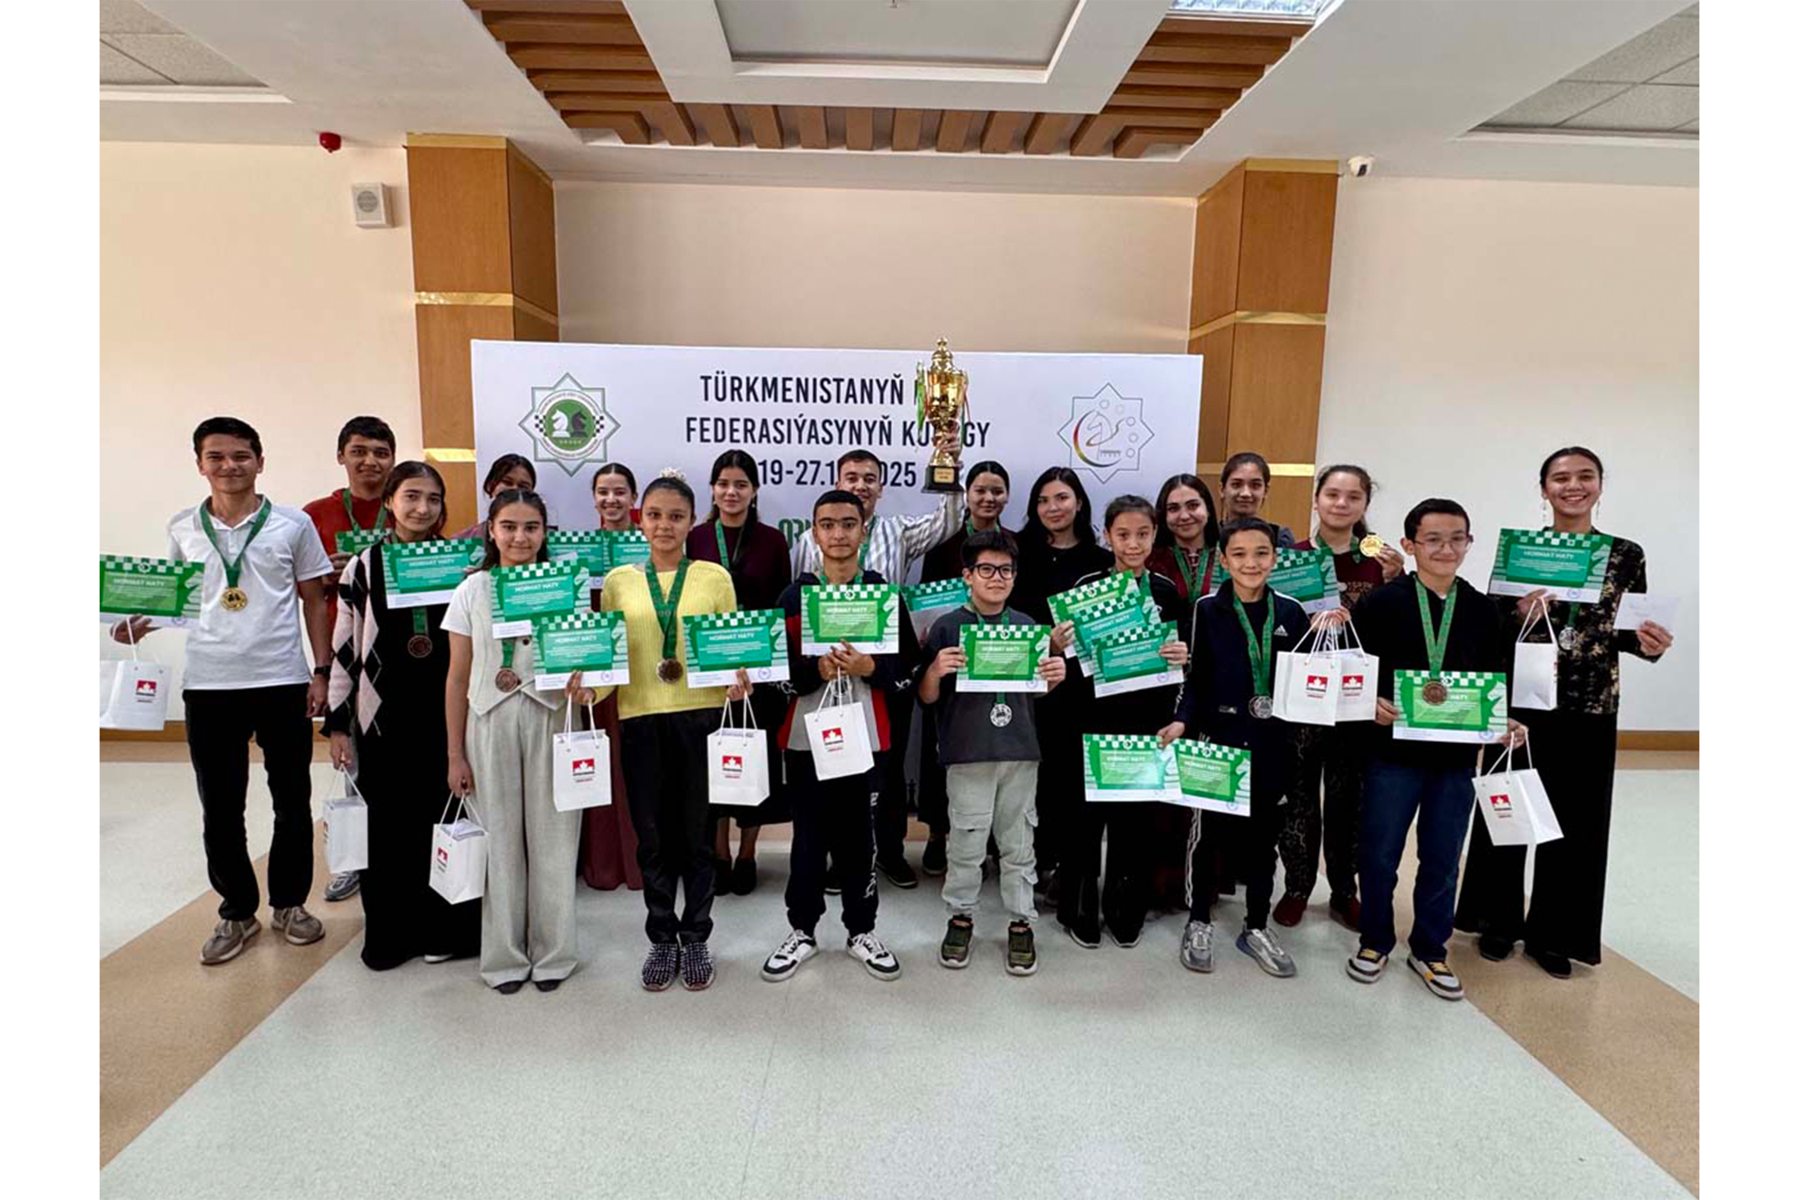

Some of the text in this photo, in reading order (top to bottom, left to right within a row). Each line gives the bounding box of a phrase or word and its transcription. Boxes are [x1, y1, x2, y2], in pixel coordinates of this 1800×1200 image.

[700, 371, 904, 406] TÜRKMENISTANYŇ
[686, 413, 991, 447] FEDERASIÝASYNYŇ KUGY
